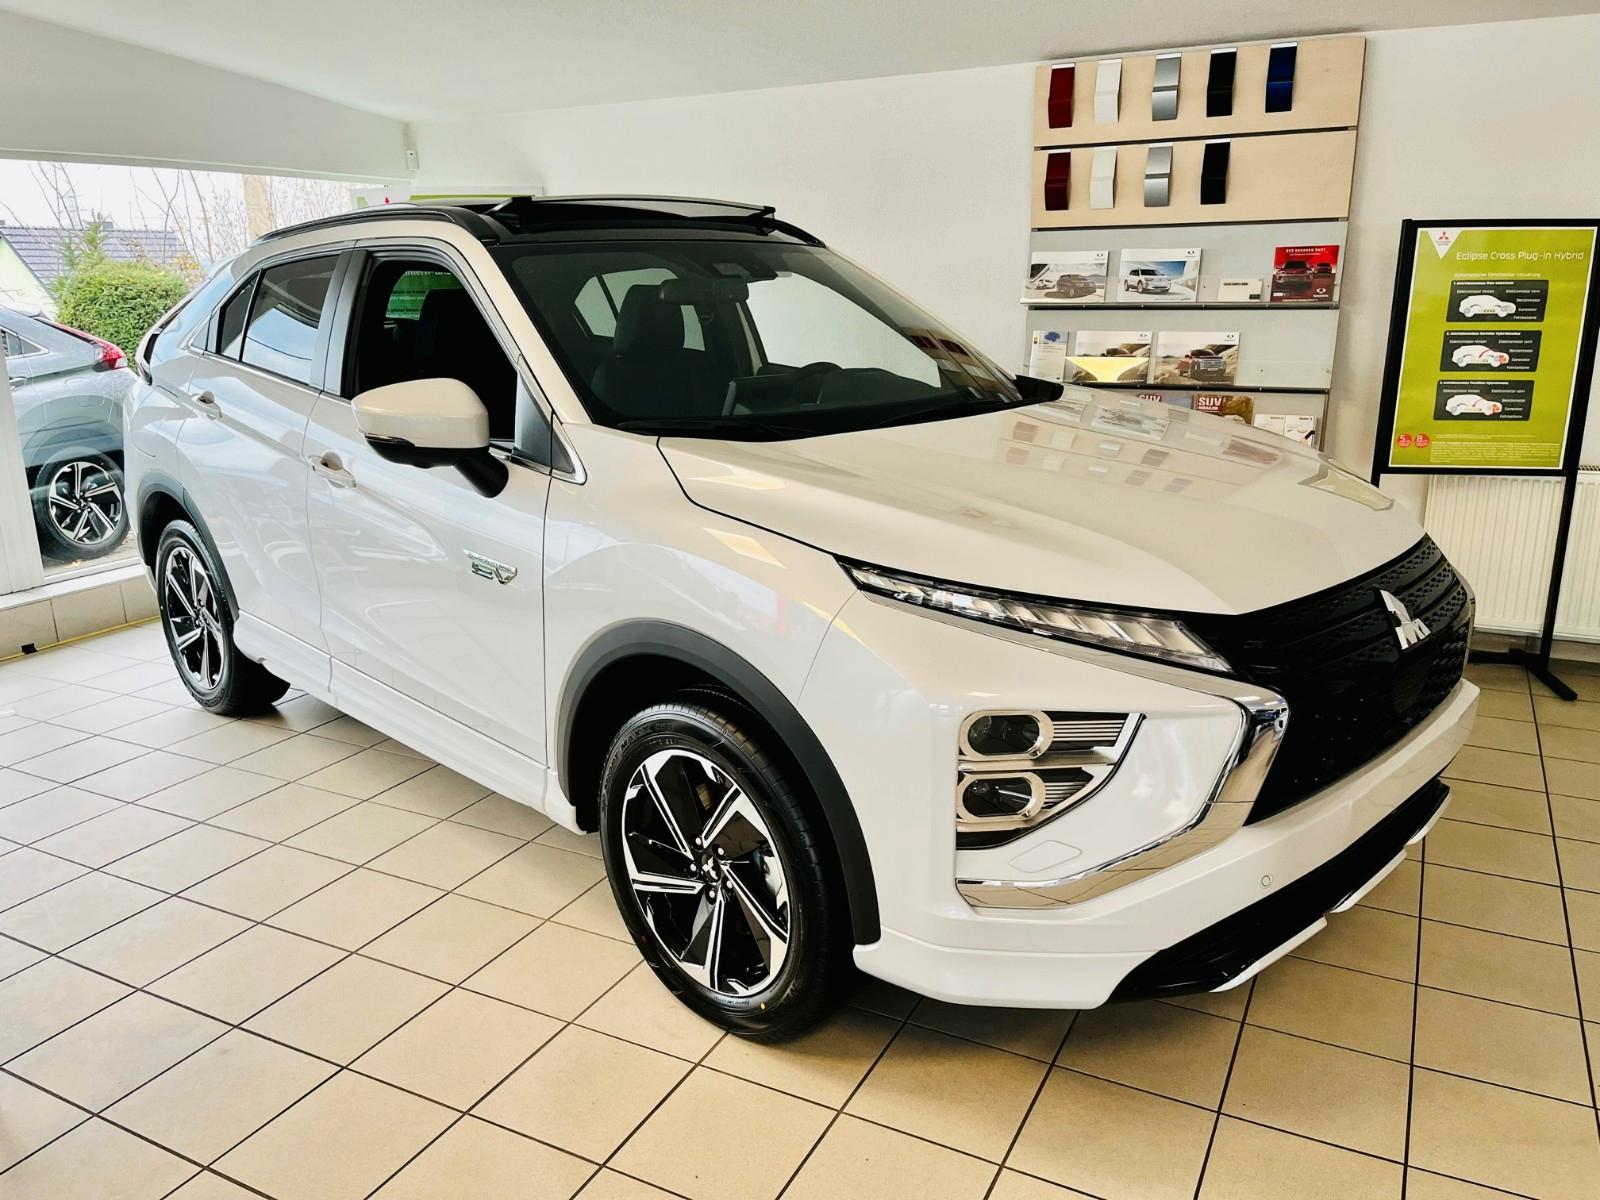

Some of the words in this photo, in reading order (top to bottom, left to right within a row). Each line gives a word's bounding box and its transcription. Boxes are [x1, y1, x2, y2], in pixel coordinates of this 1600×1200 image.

[1456, 250, 1488, 261] Eclipse
[1490, 251, 1515, 260] Cross
[1518, 250, 1552, 262] Plug-in
[1554, 250, 1584, 262] Hybrid
[1198, 397, 1222, 407] SUV
